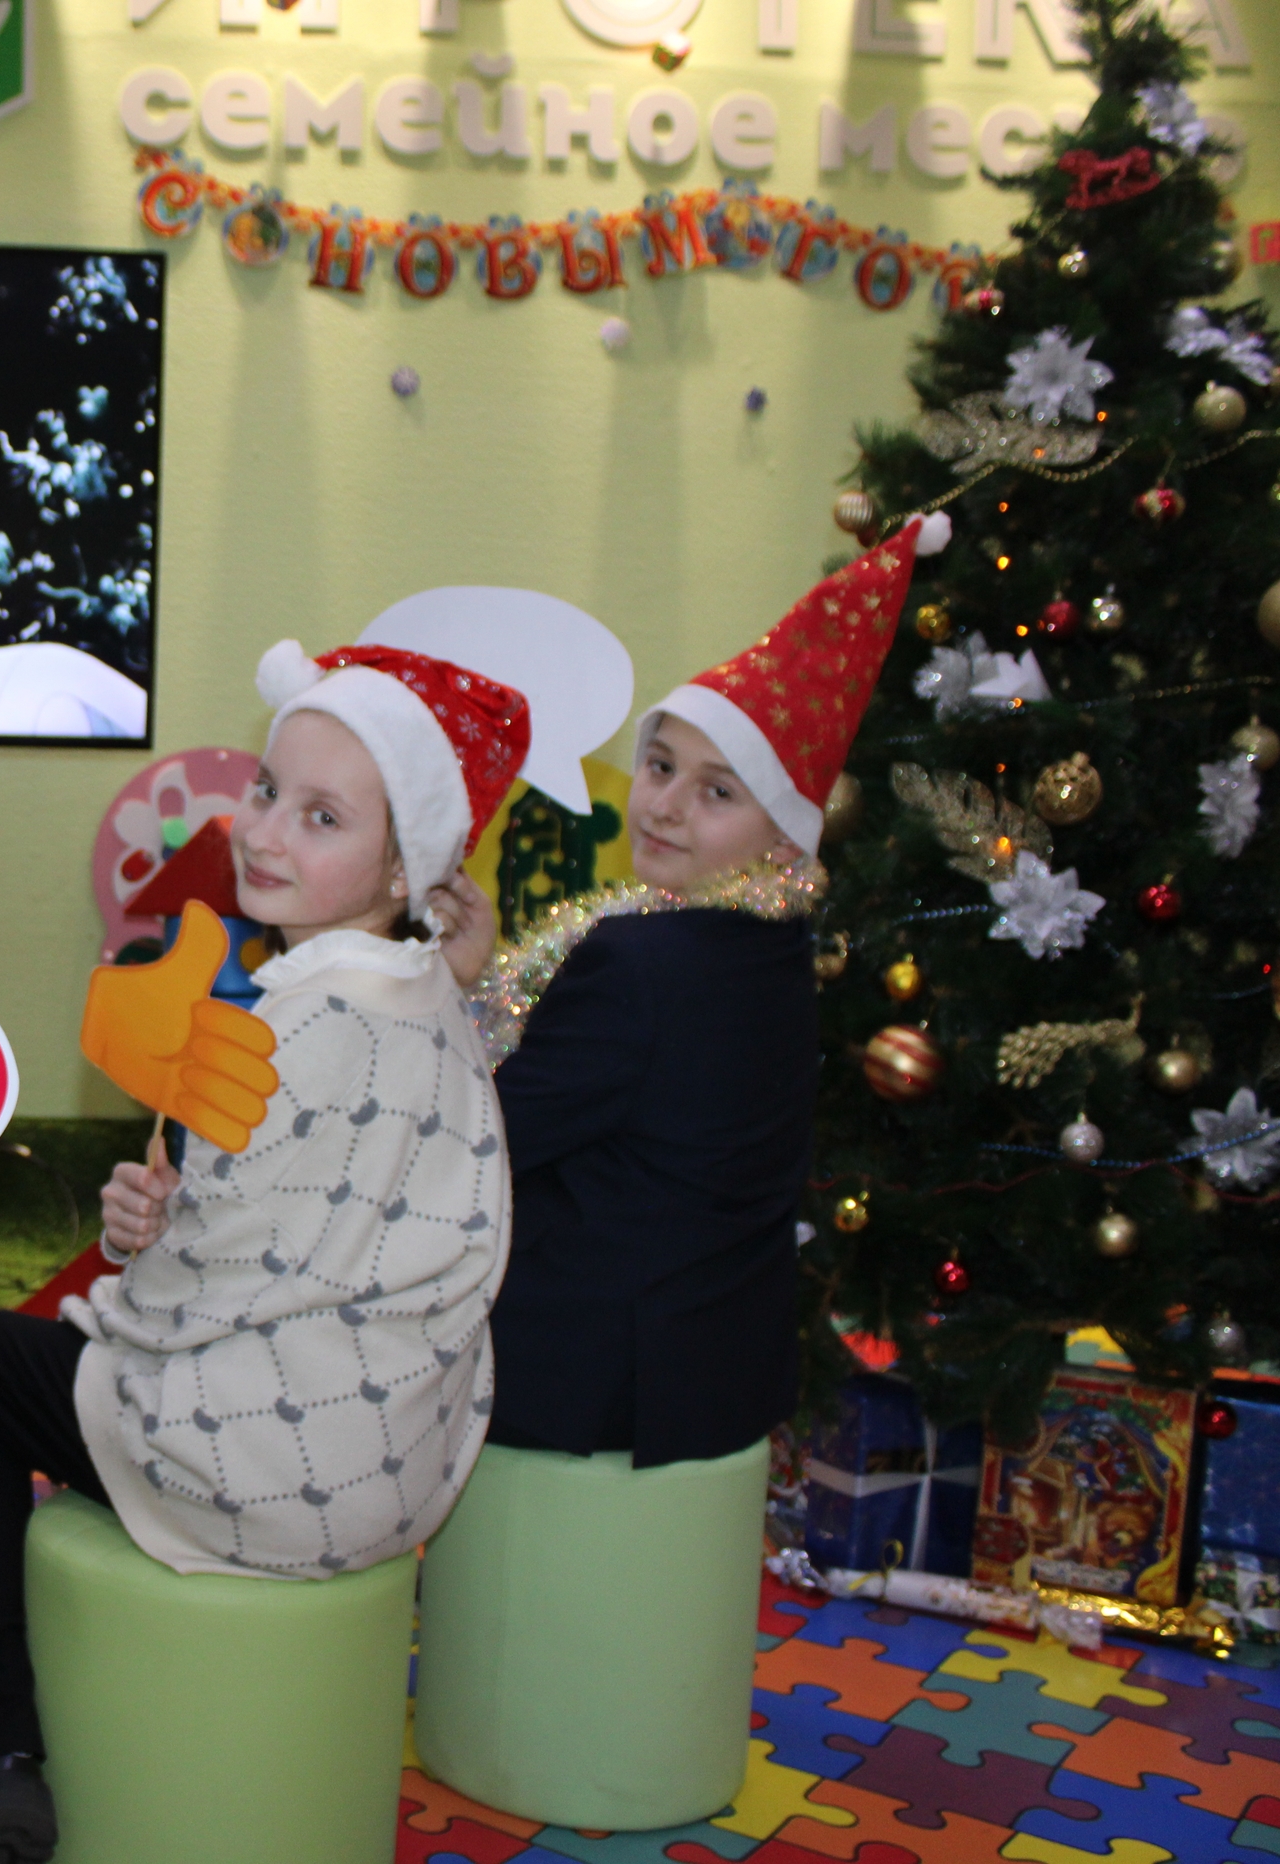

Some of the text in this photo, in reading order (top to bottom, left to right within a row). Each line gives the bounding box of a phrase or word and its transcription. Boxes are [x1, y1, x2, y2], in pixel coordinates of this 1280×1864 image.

[122, 50, 1246, 185] семейное мес
[140, 168, 201, 237] С
[308, 204, 718, 300] НОВЫМ
